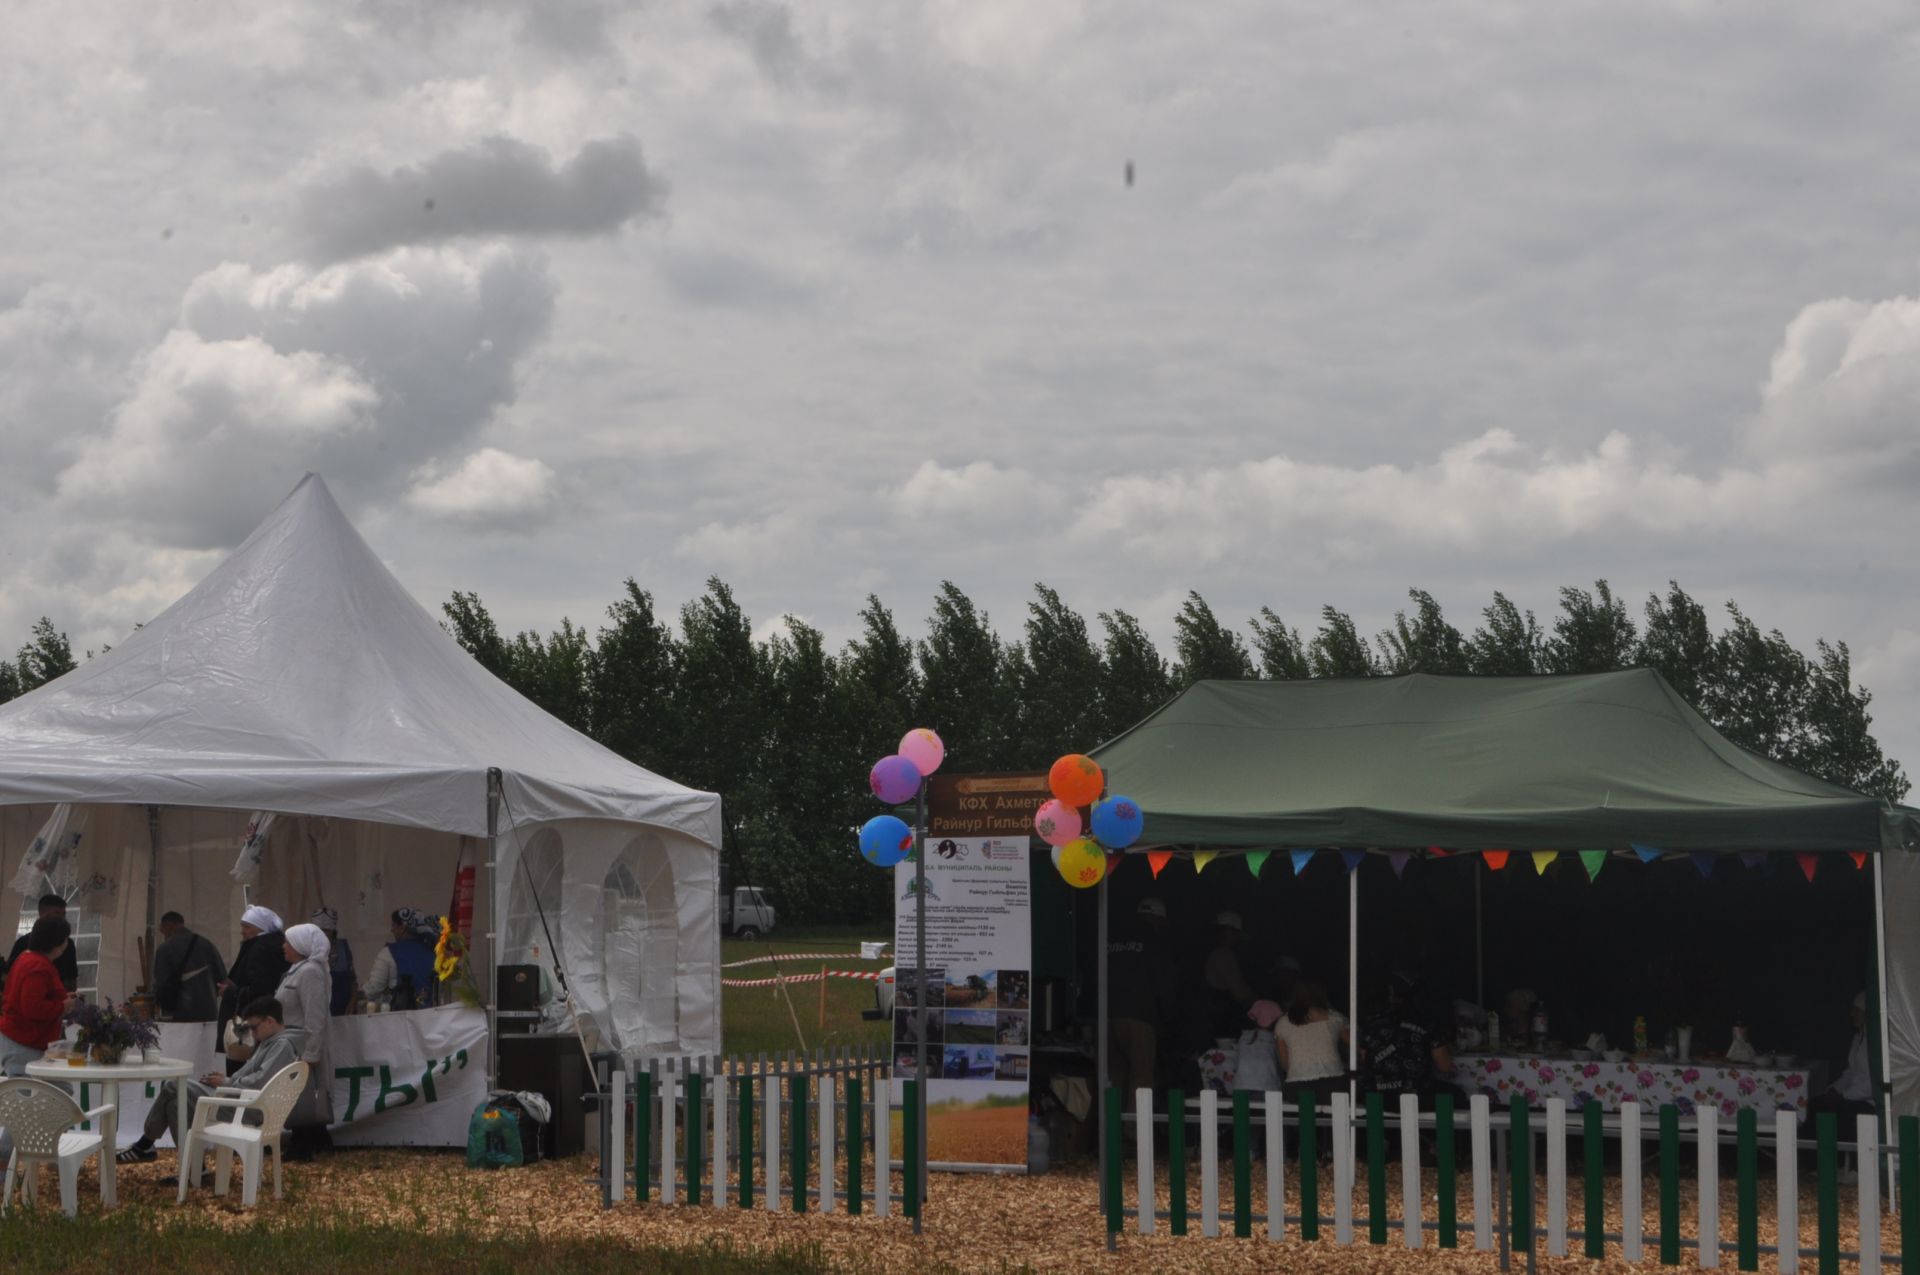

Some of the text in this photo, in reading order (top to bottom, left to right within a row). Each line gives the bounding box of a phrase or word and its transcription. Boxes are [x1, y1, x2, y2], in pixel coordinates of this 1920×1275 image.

[959, 796, 1046, 811] КФХ Ахмето
[933, 815, 1036, 832] Райнур Гильф
[335, 1048, 468, 1122] ТЫ”
